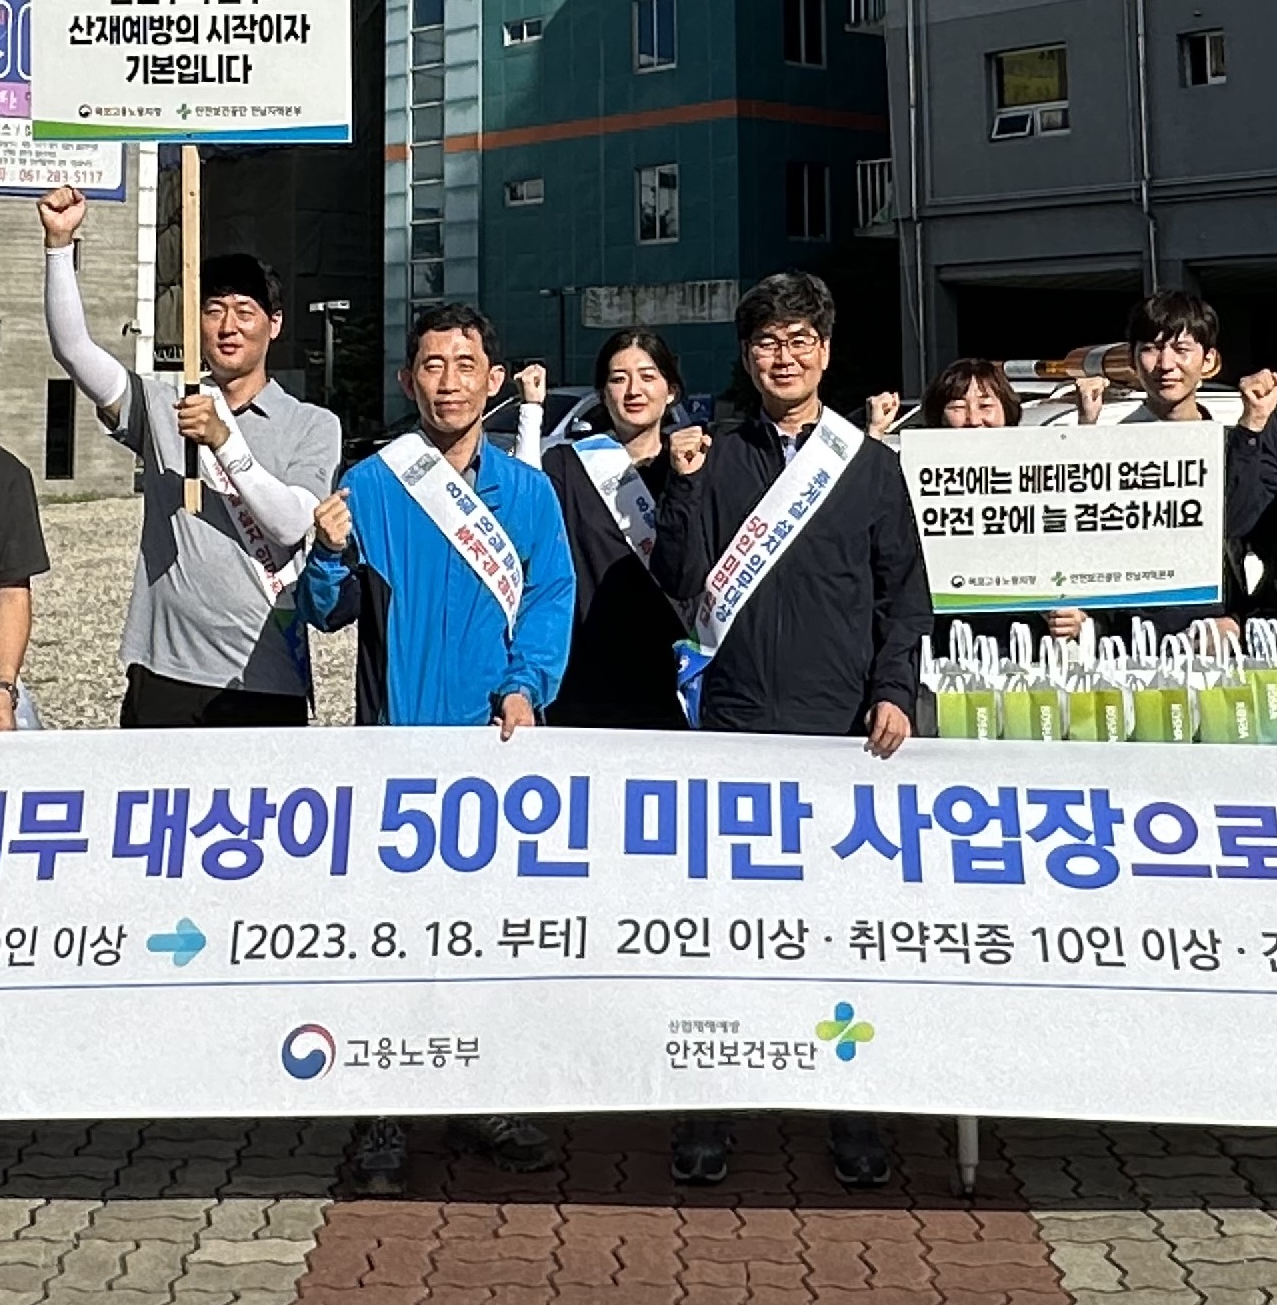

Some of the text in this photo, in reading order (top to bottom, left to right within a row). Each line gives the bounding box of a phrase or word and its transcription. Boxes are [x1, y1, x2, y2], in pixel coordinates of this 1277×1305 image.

[69, 14, 310, 46] 산재예방의 시작이자
[126, 54, 252, 84] 기본입니다
[919, 458, 1208, 497] 안전에는 베테랑이 없습니다
[446, 482, 478, 518] 8월
[473, 516, 506, 554] 18일
[759, 518, 795, 556] 설치
[922, 499, 1203, 537] 안전 앞에 늘 겸손하세요
[711, 555, 742, 593] 미만
[715, 552, 767, 623] 의무대상
[112, 786, 352, 880] 대상이
[377, 775, 590, 879] 50인
[623, 779, 813, 881] 미만
[53, 924, 127, 967] 이상
[230, 919, 358, 967] [2023.
[371, 921, 408, 962] 8.
[424, 920, 484, 960] 18.
[496, 916, 588, 960] 부터]
[616, 916, 711, 960] 20인
[728, 916, 808, 962] 이상
[848, 918, 1015, 967] 취약직종
[1031, 924, 1125, 969] 10인
[1144, 927, 1222, 972] 이상
[344, 1034, 481, 1072] 고용노동부
[666, 1039, 819, 1070] 안전보건공단
